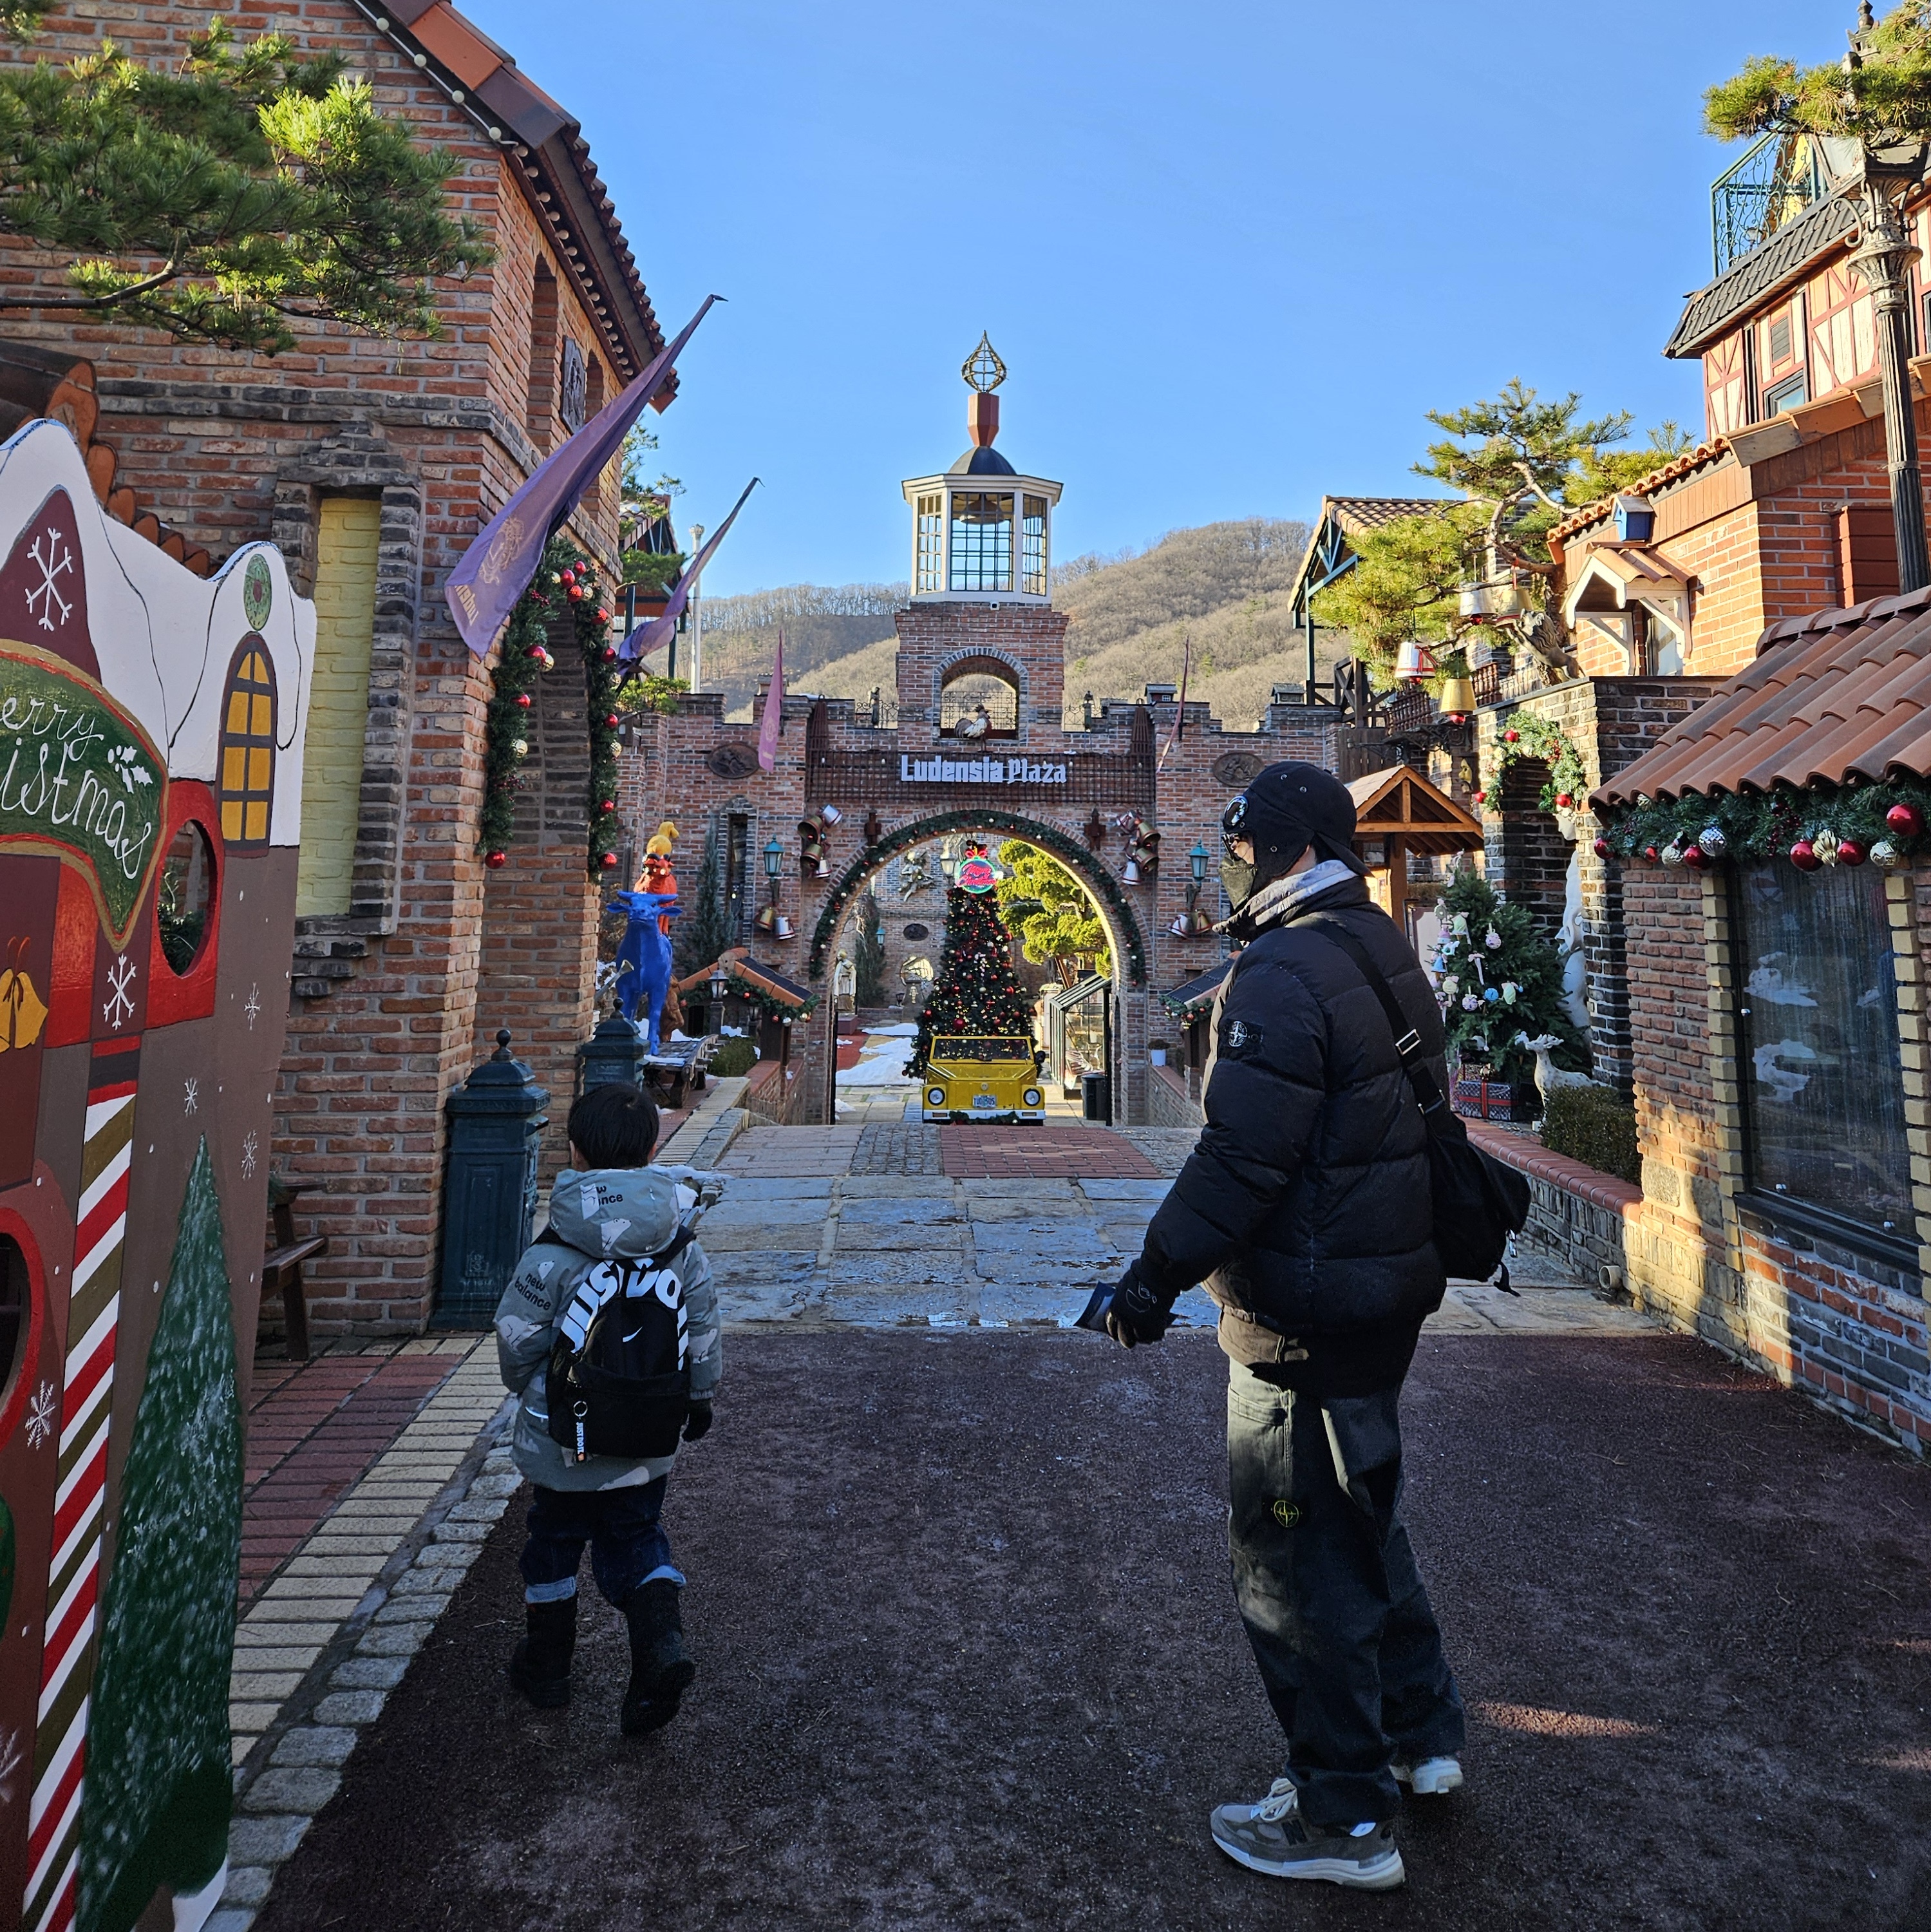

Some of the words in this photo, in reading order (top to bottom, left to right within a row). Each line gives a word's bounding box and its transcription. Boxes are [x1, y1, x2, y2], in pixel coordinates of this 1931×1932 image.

[0, 697, 104, 761] erry
[901, 754, 1003, 783] Ludensia
[1007, 757, 1067, 785] Plaza
[0, 737, 152, 880] istmas
[514, 1276, 552, 1311] balance
[525, 1273, 546, 1292] new
[576, 1421, 584, 1437] JUST
[576, 1437, 585, 1446] DO
